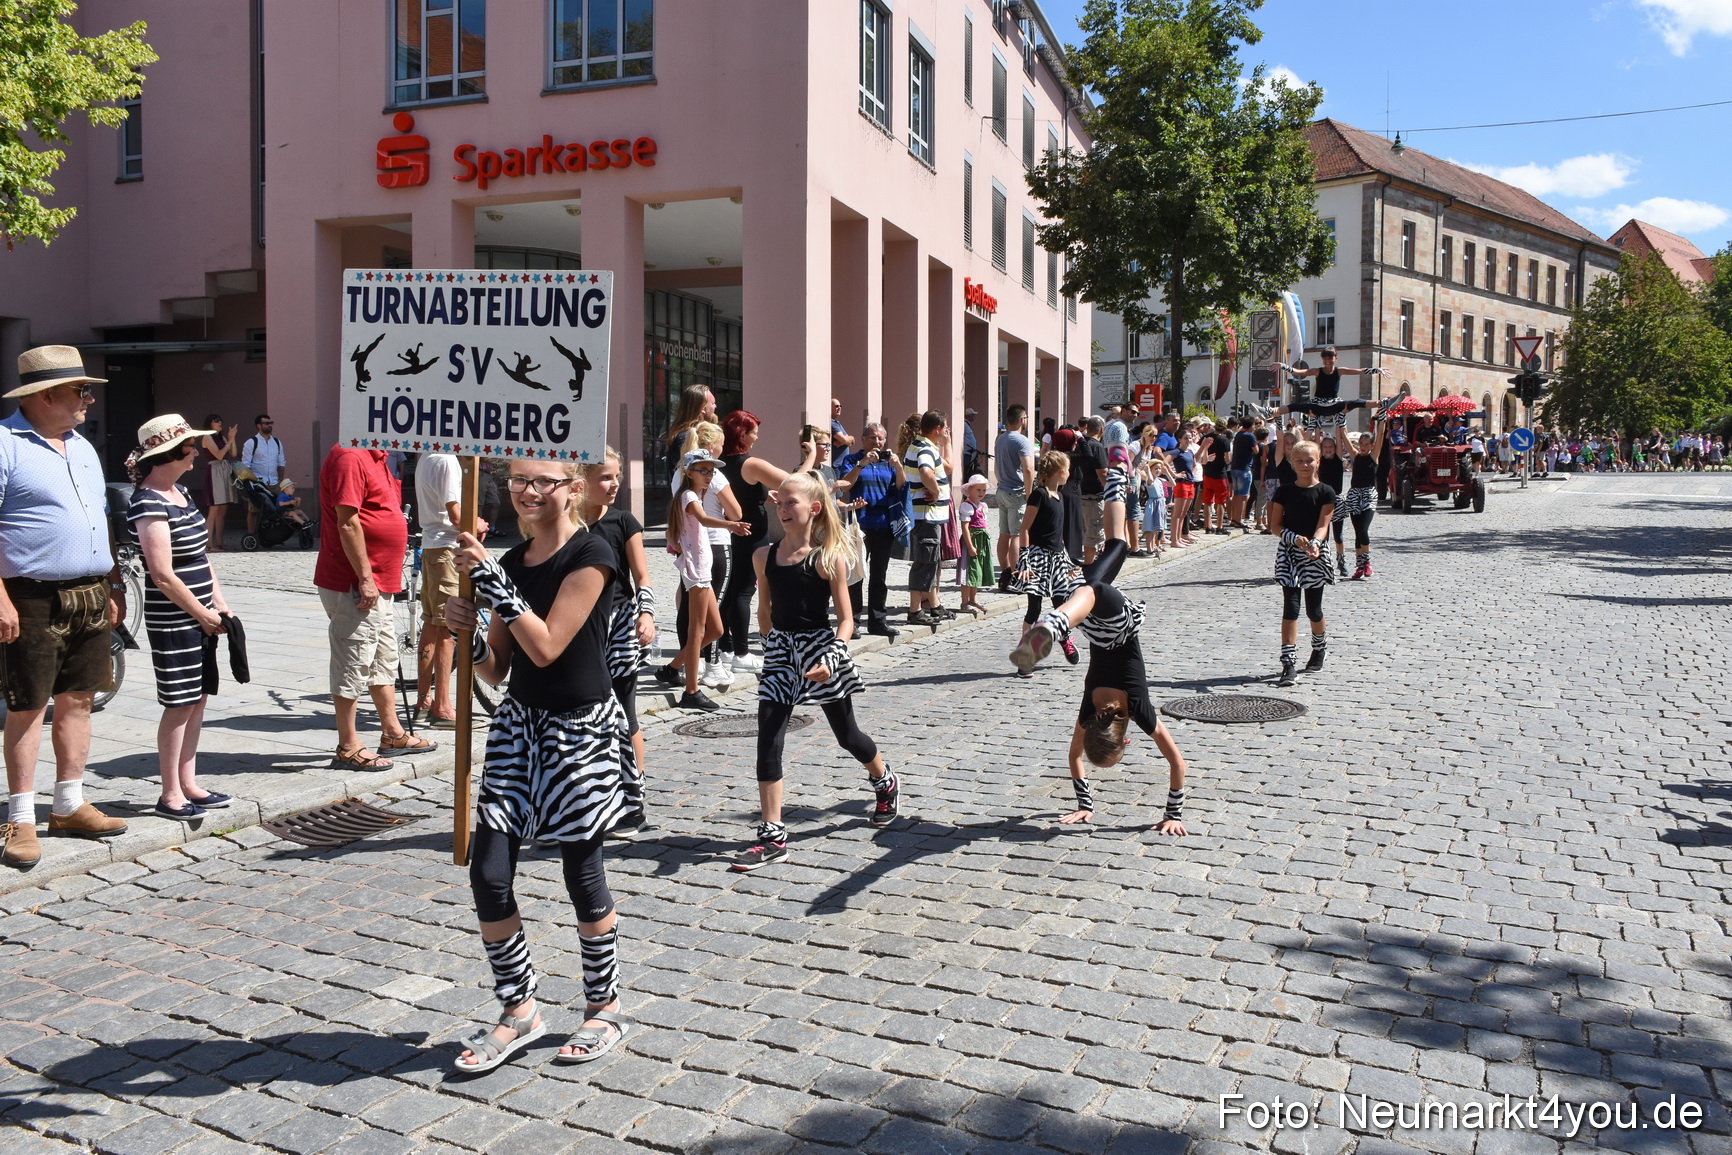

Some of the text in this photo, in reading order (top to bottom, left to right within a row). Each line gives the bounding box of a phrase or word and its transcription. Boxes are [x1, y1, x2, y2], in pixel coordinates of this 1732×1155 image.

[453, 134, 657, 190] Sparkasse
[346, 286, 606, 329] TURNABTEILUNG
[964, 277, 998, 314] Sparkasse
[448, 344, 494, 385] SV
[659, 341, 712, 364] wochenblatt
[368, 387, 571, 443] HÖHENBERG
